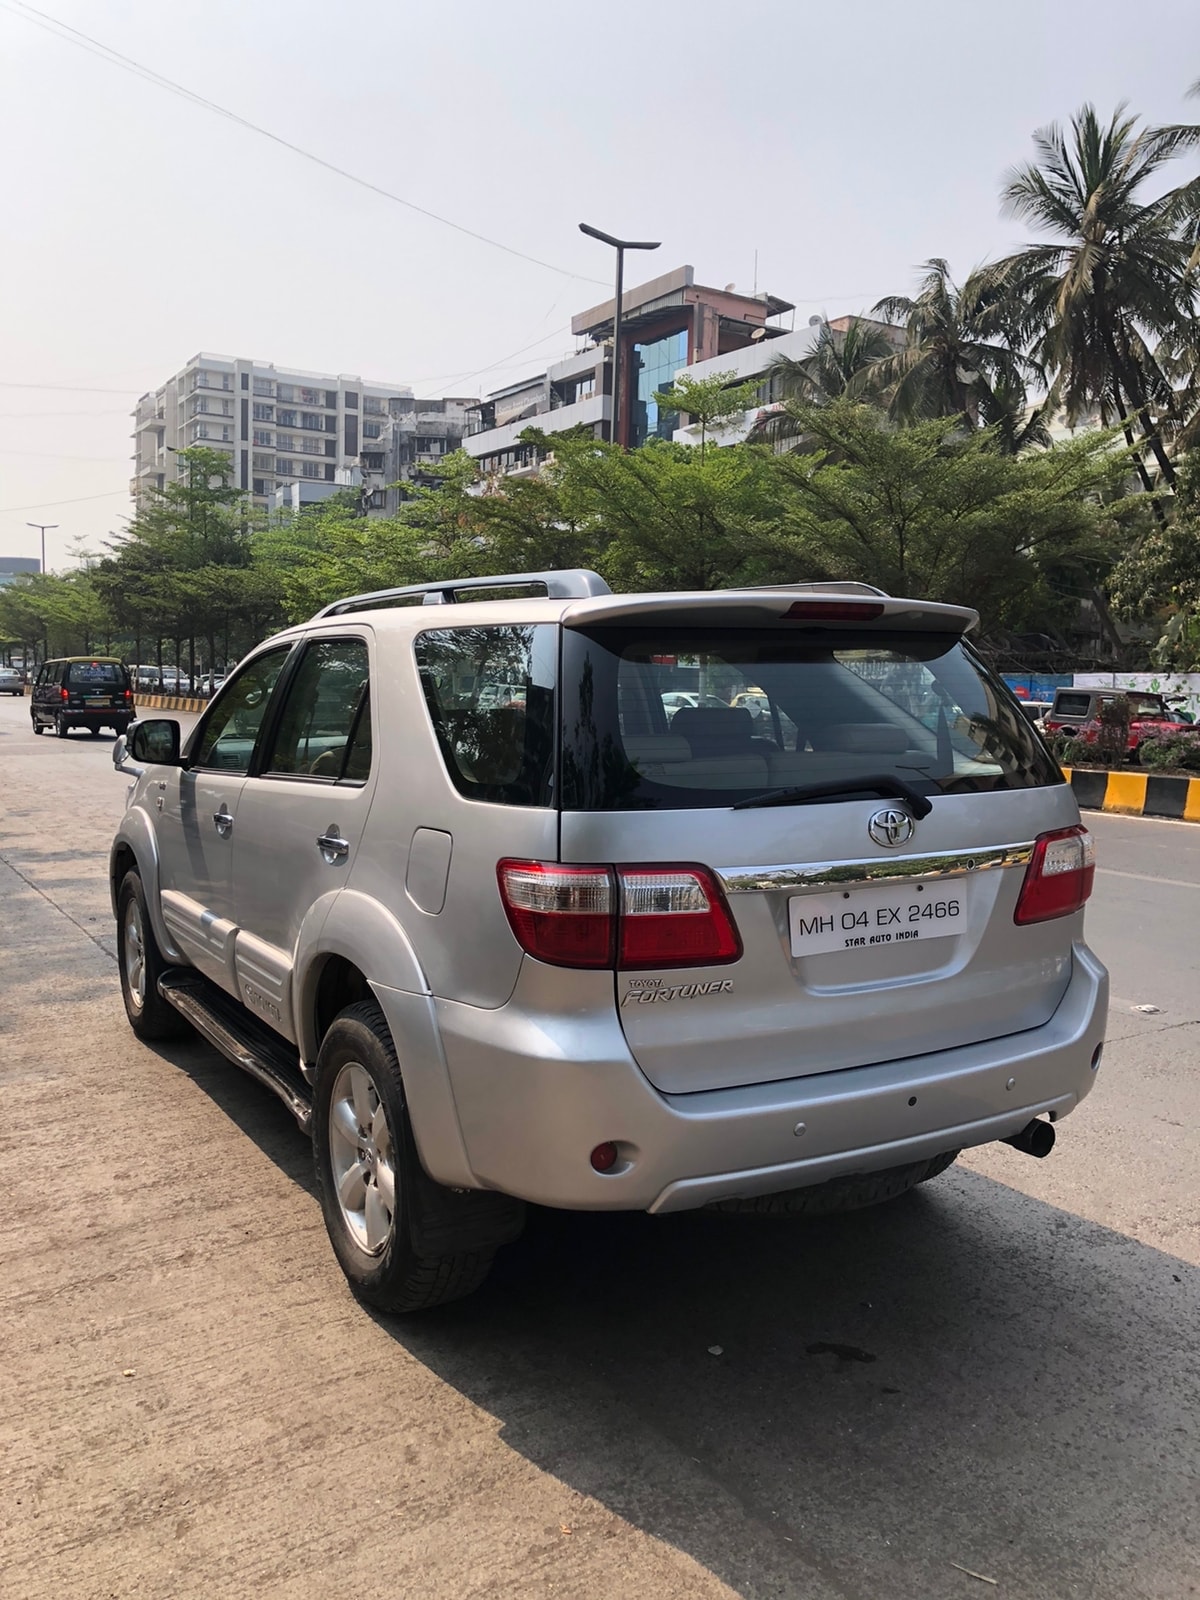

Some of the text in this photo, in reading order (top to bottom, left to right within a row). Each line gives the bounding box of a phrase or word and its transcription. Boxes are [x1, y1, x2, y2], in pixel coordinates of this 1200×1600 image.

[800, 900, 960, 936] MH 04 EX 2466
[844, 929, 919, 948] STAR AUTO INDIA
[621, 980, 734, 1007] FORTUNER
[629, 979, 665, 988] TOYOTA
